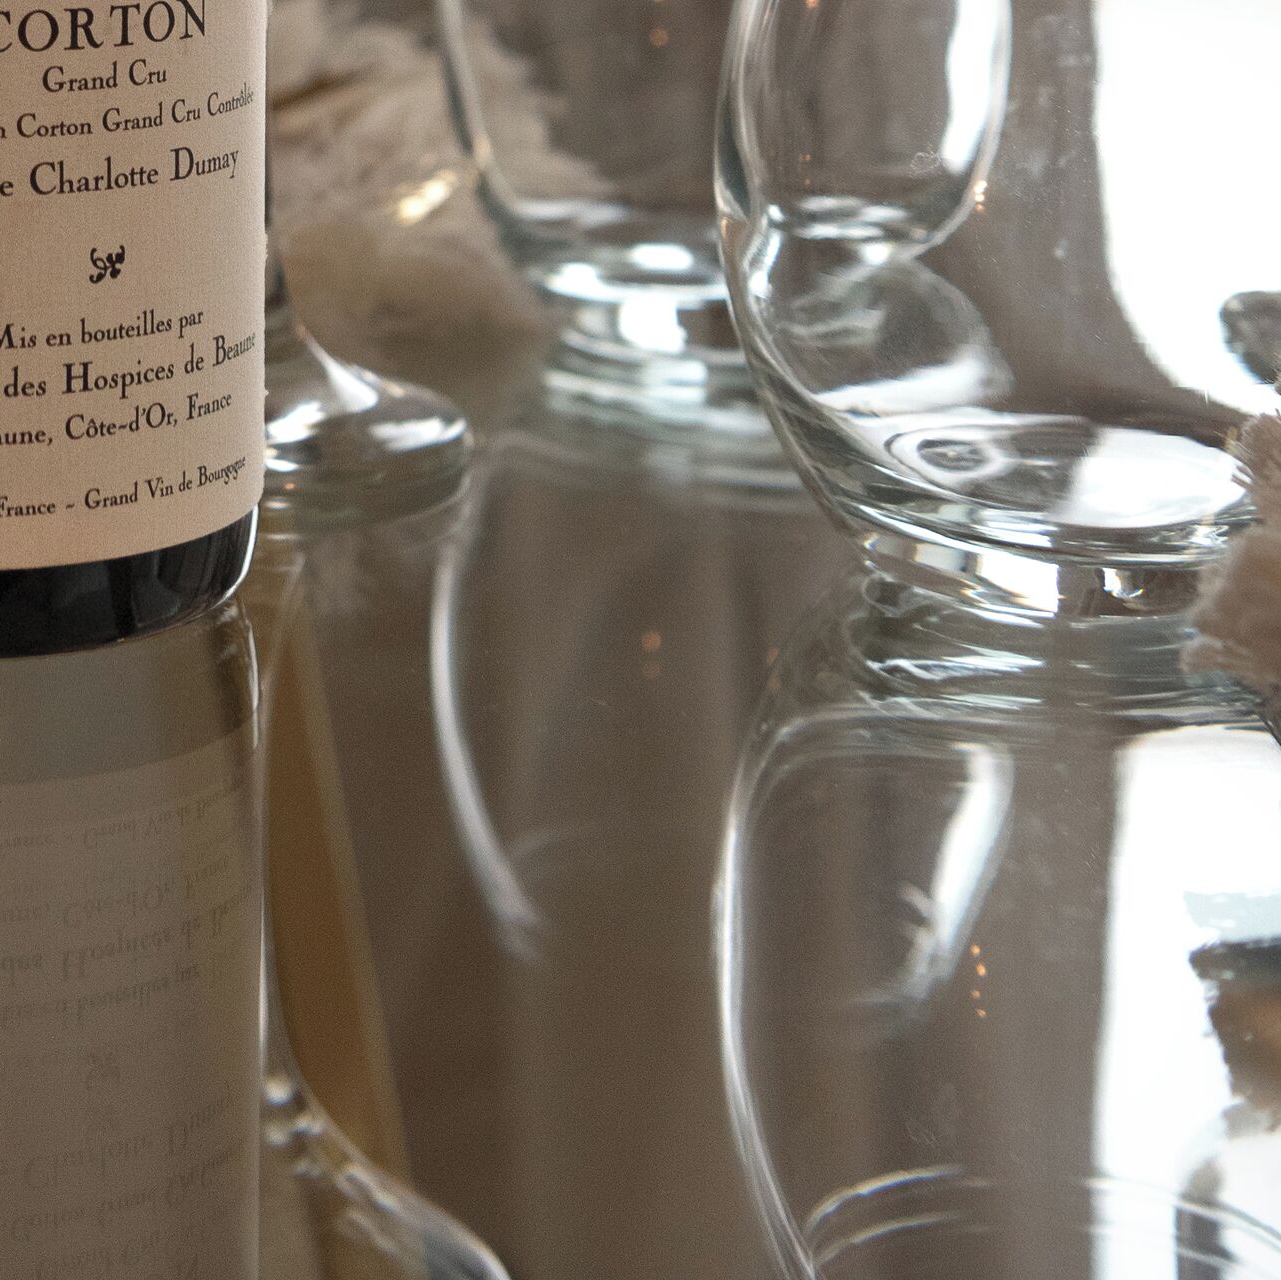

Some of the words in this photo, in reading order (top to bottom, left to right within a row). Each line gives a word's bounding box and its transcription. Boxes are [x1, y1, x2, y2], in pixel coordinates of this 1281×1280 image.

[42, 61, 118, 93] Grand
[128, 59, 167, 86] Cru
[16, 113, 93, 139] Corton
[102, 102, 164, 133] Grand
[171, 98, 201, 124] Cru
[29, 157, 159, 195] Charlotte
[169, 146, 240, 181] Dumay
[45, 330, 73, 348] en
[80, 310, 172, 344] bouteilles
[178, 310, 204, 339] par
[3, 367, 47, 397] des
[62, 359, 175, 400] Hospices
[184, 343, 205, 374] de
[212, 331, 256, 367] Beaune
[186, 392, 232, 421] France
[84, 481, 138, 510] Grand
[145, 477, 174, 500] Vin
[178, 470, 193, 493] de
[197, 456, 246, 487] Bourgogne
